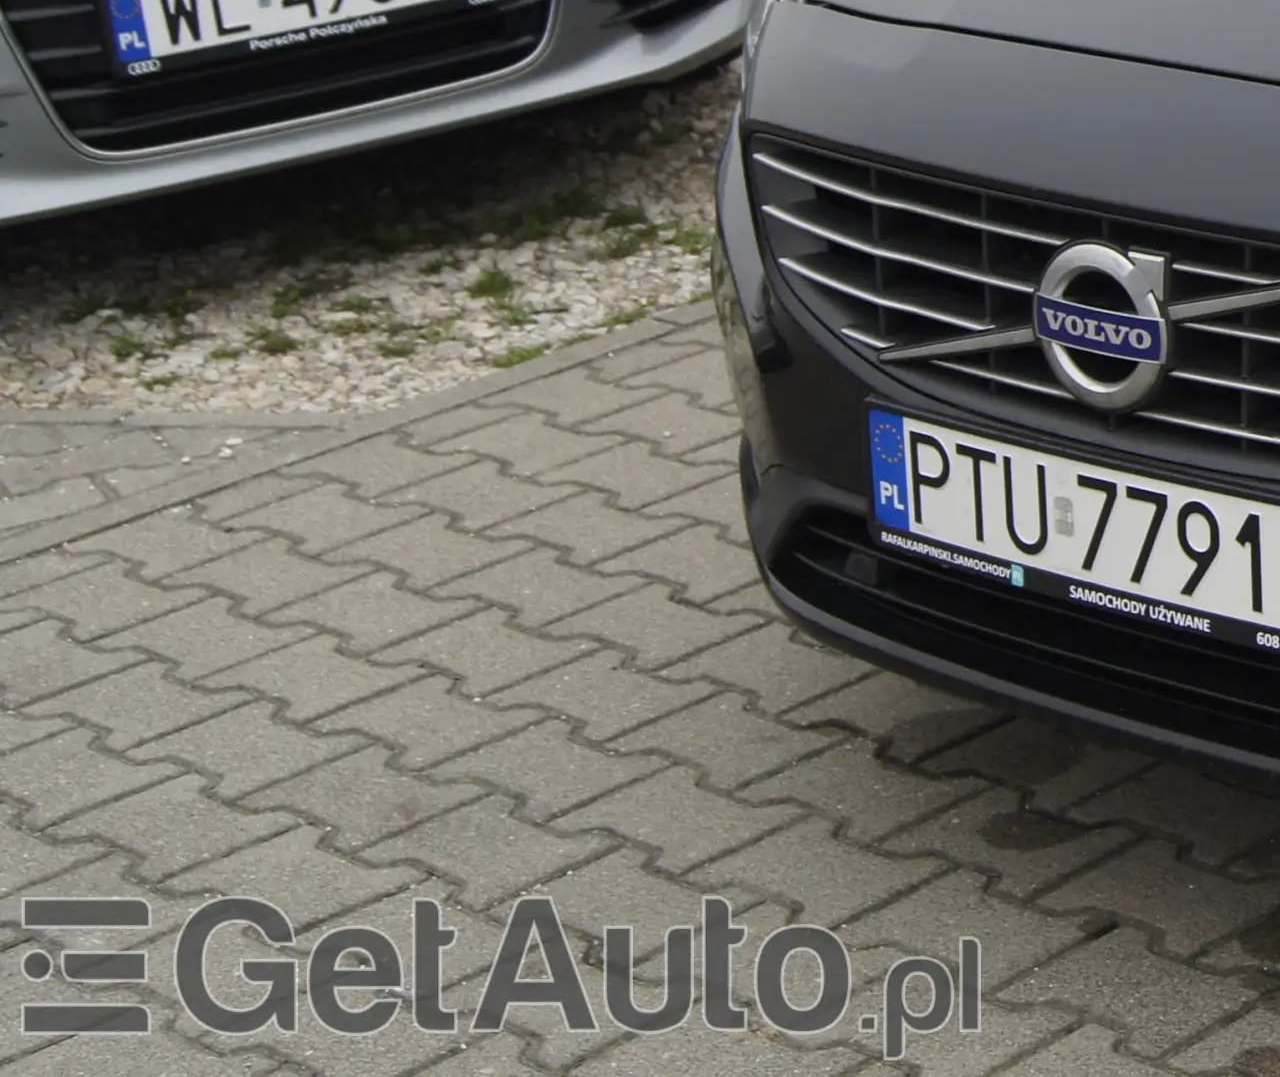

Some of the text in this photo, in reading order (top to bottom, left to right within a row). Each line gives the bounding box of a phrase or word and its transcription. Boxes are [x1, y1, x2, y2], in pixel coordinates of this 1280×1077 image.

[117, 30, 146, 52] PL
[249, 30, 307, 51] Porsche
[1041, 306, 1152, 350] VOLVO
[879, 481, 905, 511] PL
[908, 429, 1047, 557] PTU
[1068, 584, 1212, 634] SAMOCHODY UŻYWANE
[1256, 631, 1280, 650] 608
